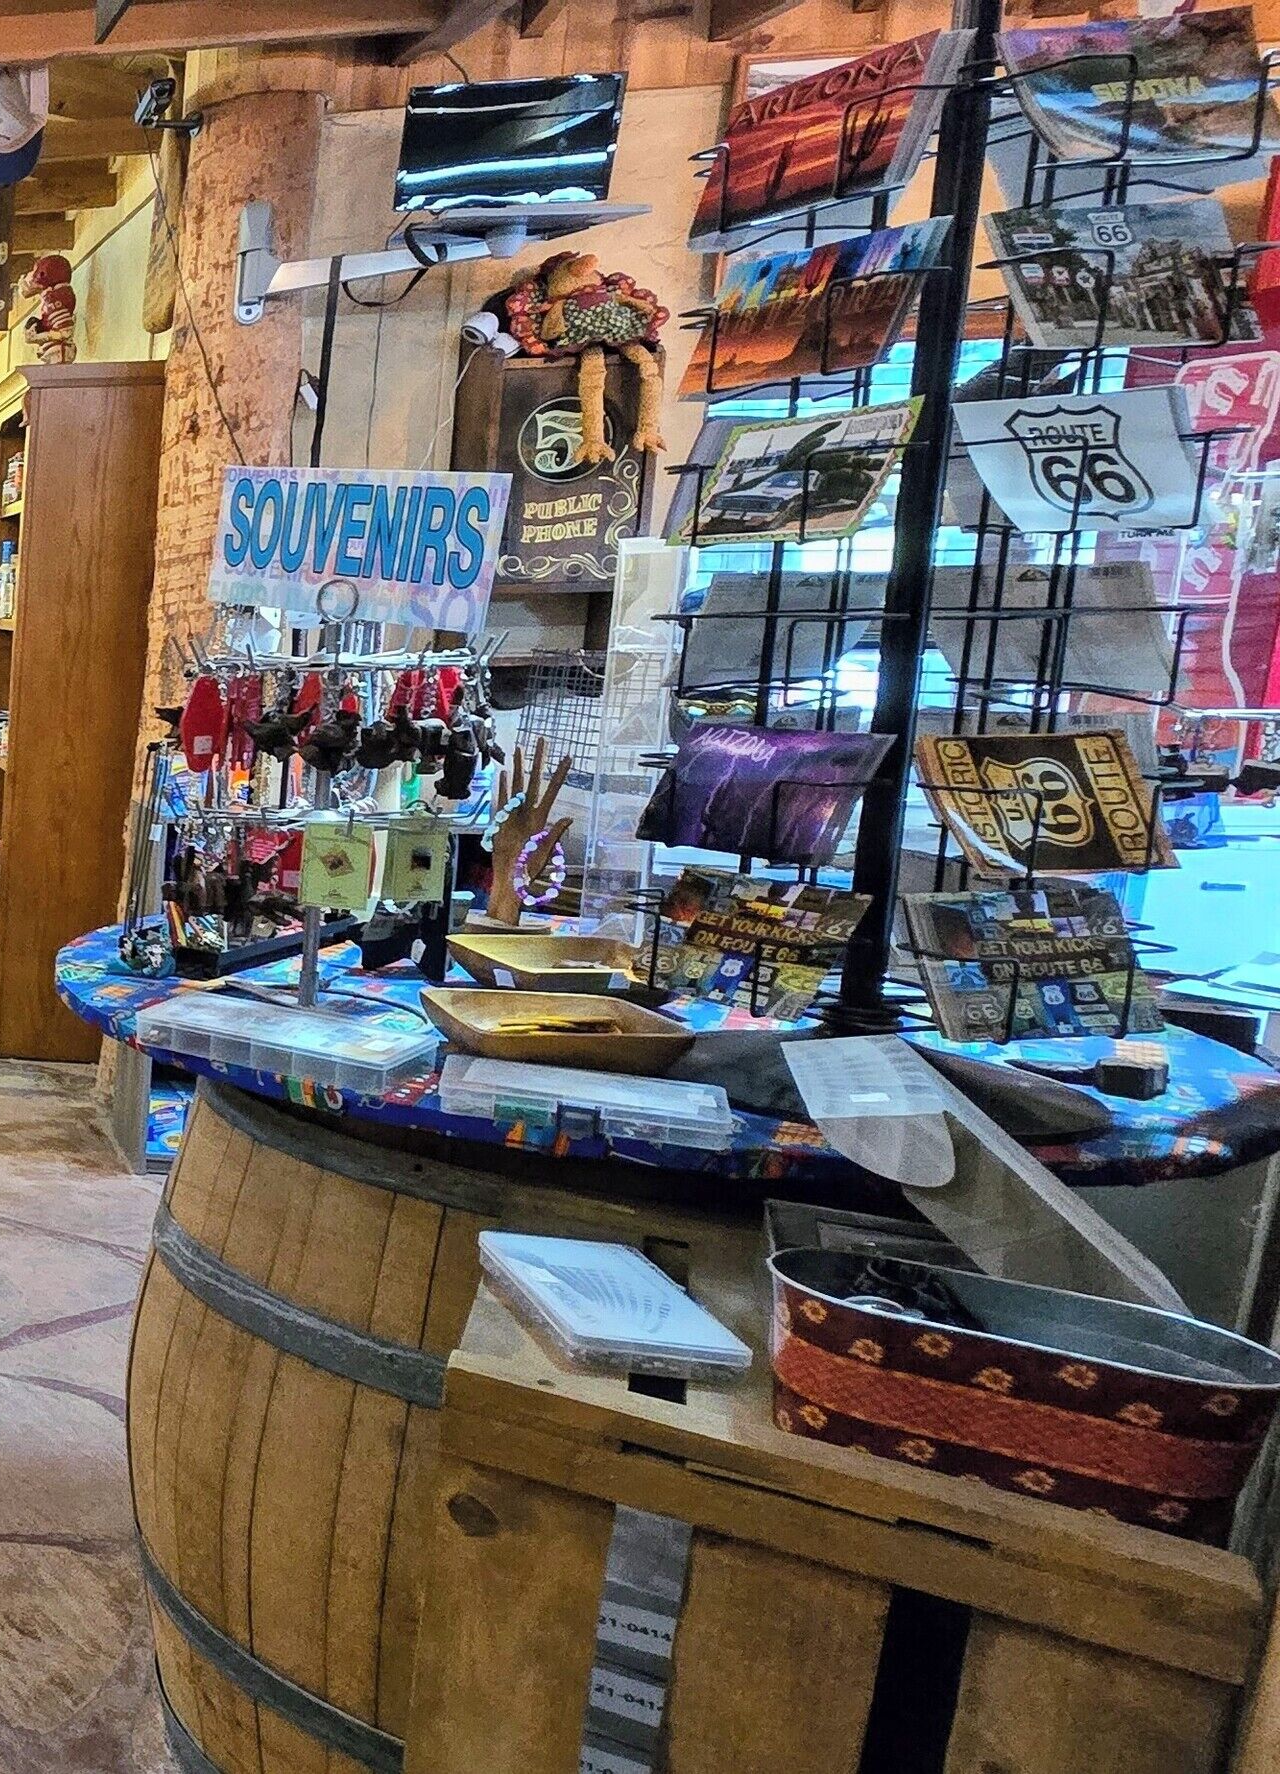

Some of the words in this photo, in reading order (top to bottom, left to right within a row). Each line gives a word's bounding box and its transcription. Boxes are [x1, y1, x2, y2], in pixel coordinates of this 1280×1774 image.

[731, 40, 925, 127] ARIZONA
[1096, 224, 1129, 243] 66
[1028, 422, 1108, 446] ROUTE
[1041, 453, 1137, 504] 66
[523, 493, 603, 519] PUBLIC
[224, 478, 490, 590] SOUVENIRS
[520, 517, 598, 543] PHONE
[942, 742, 1002, 850] ISTORIC
[1084, 746, 1143, 853] ROUTE
[696, 911, 726, 927] GET
[729, 917, 770, 937] YOUR
[769, 924, 824, 944] KICKS
[693, 930, 717, 945] ON
[721, 935, 774, 958] ROUE
[975, 941, 1009, 957] GET
[1009, 939, 1054, 957] YOUR
[1054, 937, 1107, 954] KICKS
[992, 963, 1015, 979] ON
[1018, 960, 1077, 979] ROUTE
